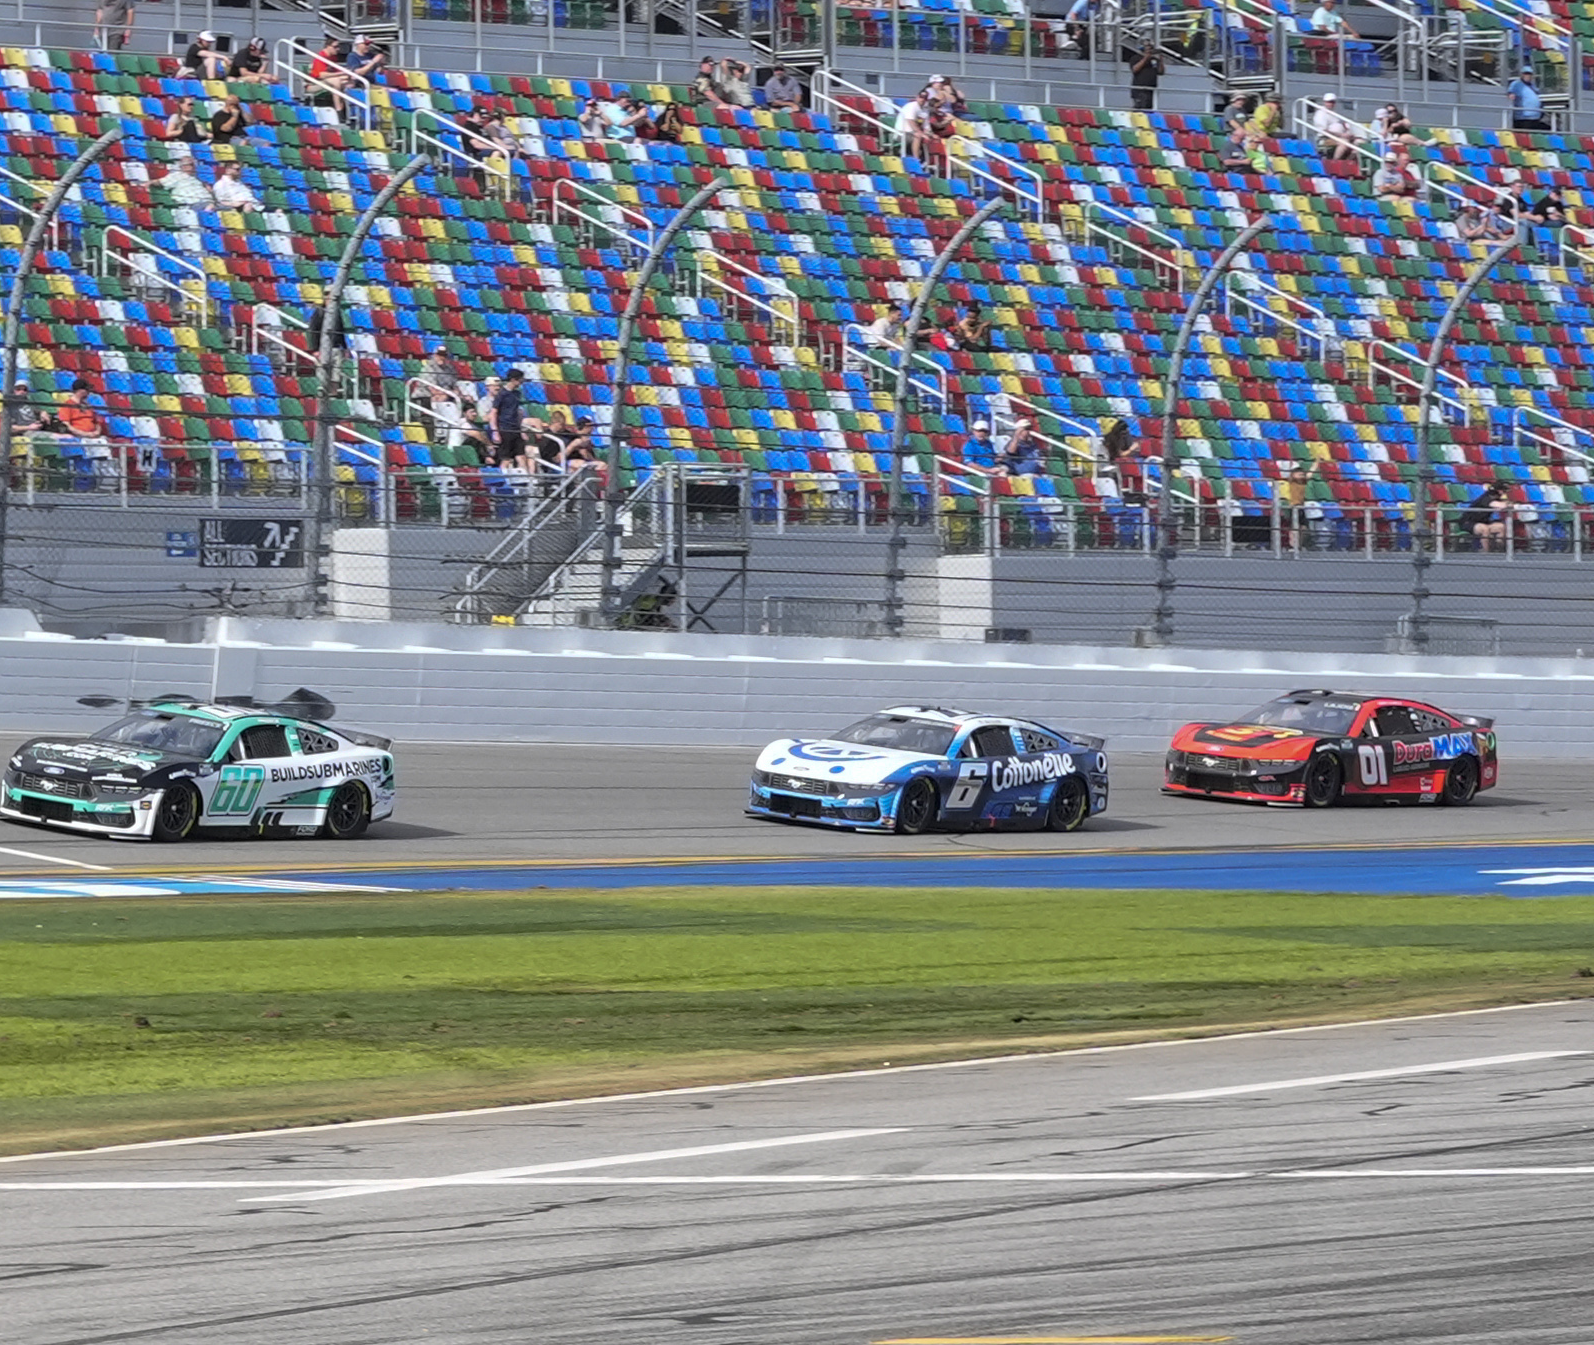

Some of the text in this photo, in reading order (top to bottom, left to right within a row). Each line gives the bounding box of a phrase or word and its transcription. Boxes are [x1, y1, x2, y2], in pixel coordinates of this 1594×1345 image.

[203, 522, 224, 542] ALL
[203, 545, 257, 567] SECTIONS
[271, 759, 382, 783] BUILDSUBMARINES
[991, 752, 1076, 792] Cottonelle
[1357, 744, 1388, 785] 01
[207, 764, 265, 816] 60
[945, 762, 987, 809] 6
